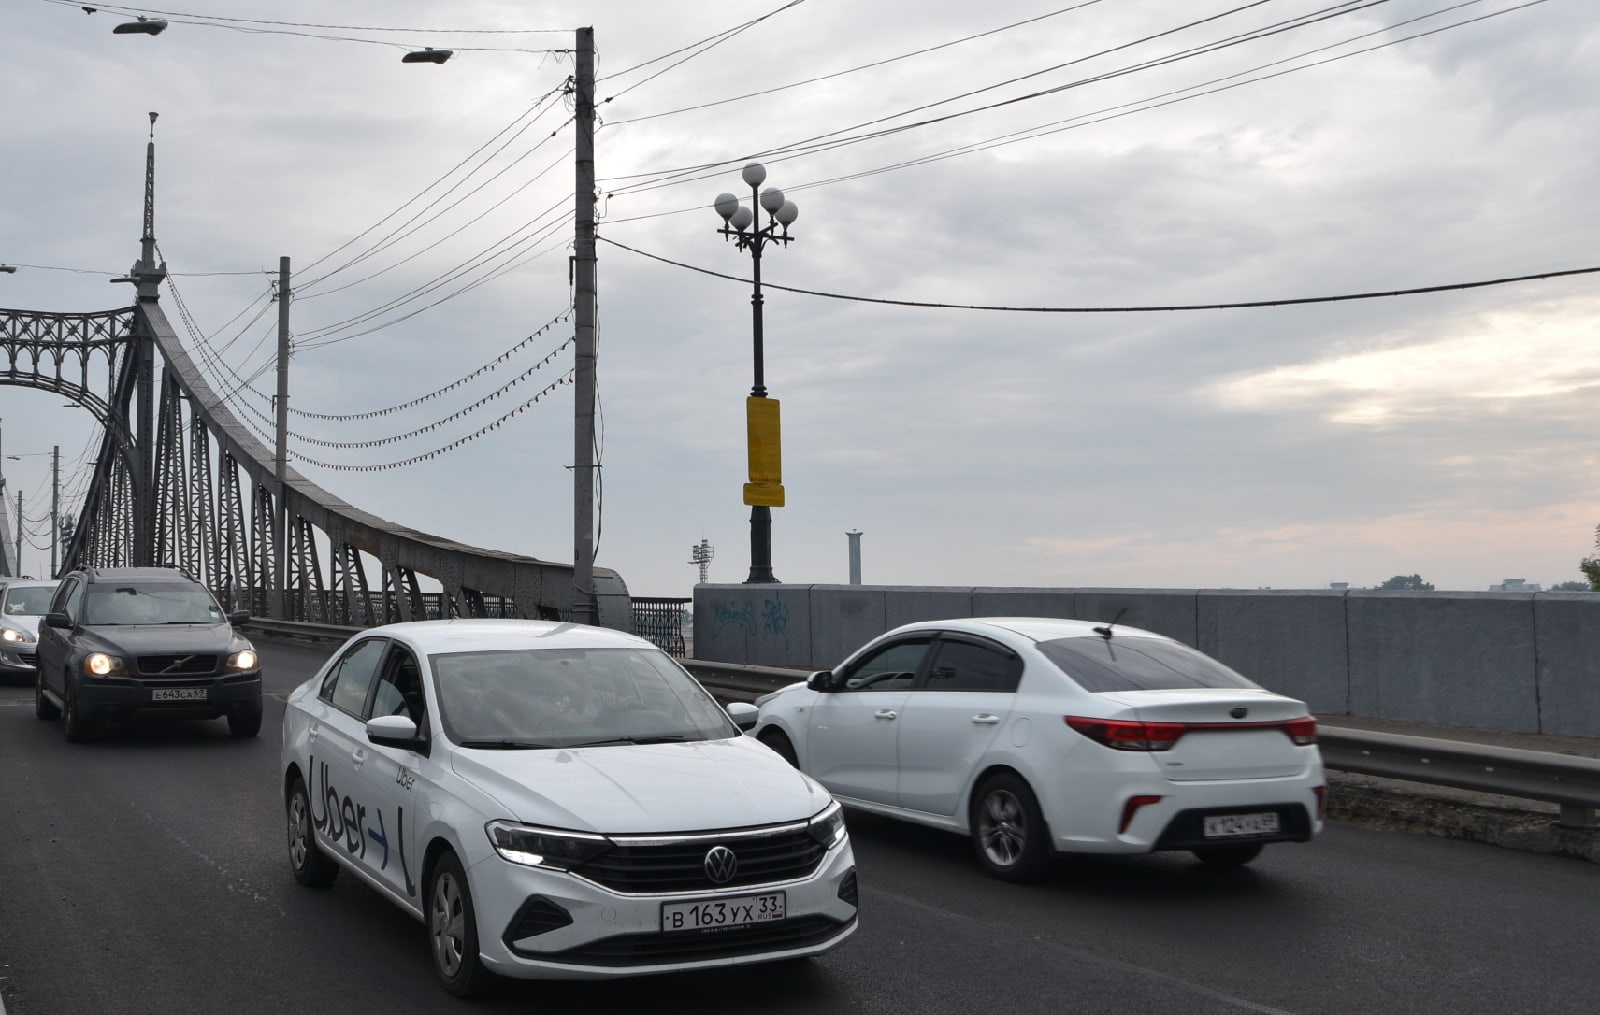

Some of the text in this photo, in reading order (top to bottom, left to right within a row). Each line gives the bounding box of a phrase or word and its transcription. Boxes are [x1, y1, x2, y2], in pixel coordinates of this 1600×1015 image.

[395, 766, 416, 792] Uber
[309, 754, 367, 860] Uber
[758, 896, 778, 913] 33
